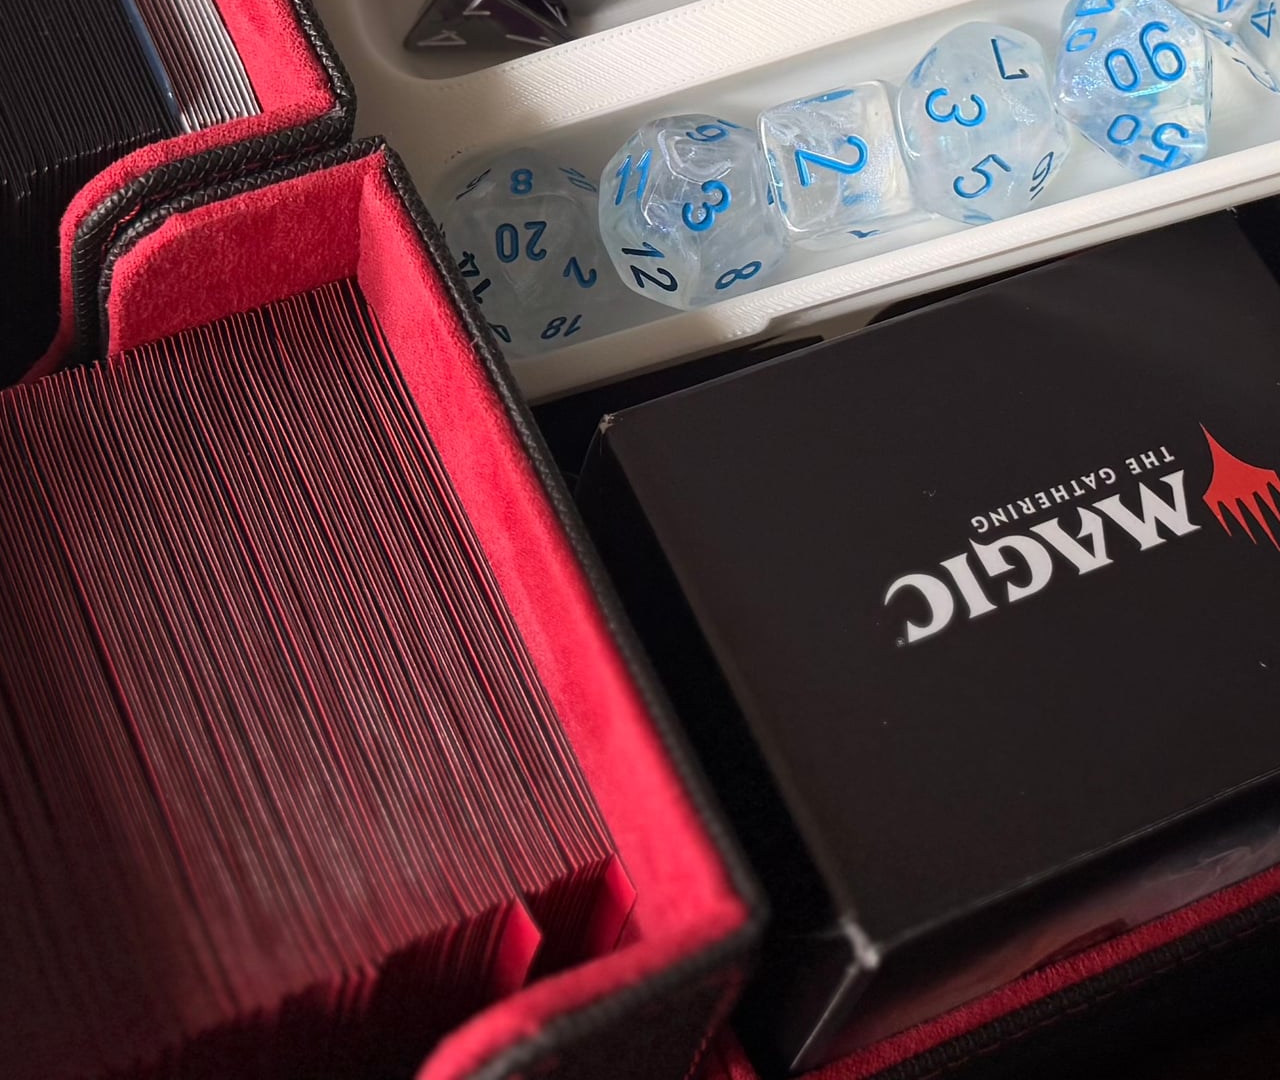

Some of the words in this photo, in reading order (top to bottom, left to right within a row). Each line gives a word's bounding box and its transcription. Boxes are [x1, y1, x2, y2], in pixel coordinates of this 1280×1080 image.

[1250, 2, 1276, 38] 4
[1104, 21, 1187, 92] 90
[925, 88, 987, 127] 3
[795, 135, 868, 187] 2
[1107, 114, 1190, 169] 50
[510, 168, 533, 195] 8
[615, 149, 652, 206] 11
[953, 154, 1012, 199] 5
[682, 179, 731, 232] 3
[495, 221, 548, 263] 20
[563, 256, 597, 288] 2
[622, 242, 678, 292] 12
[715, 261, 762, 289] 8
[541, 314, 583, 339] 18
[1125, 446, 1175, 475] THE
[971, 467, 1117, 533] GATHERING
[883, 469, 1203, 643] MAGIC
